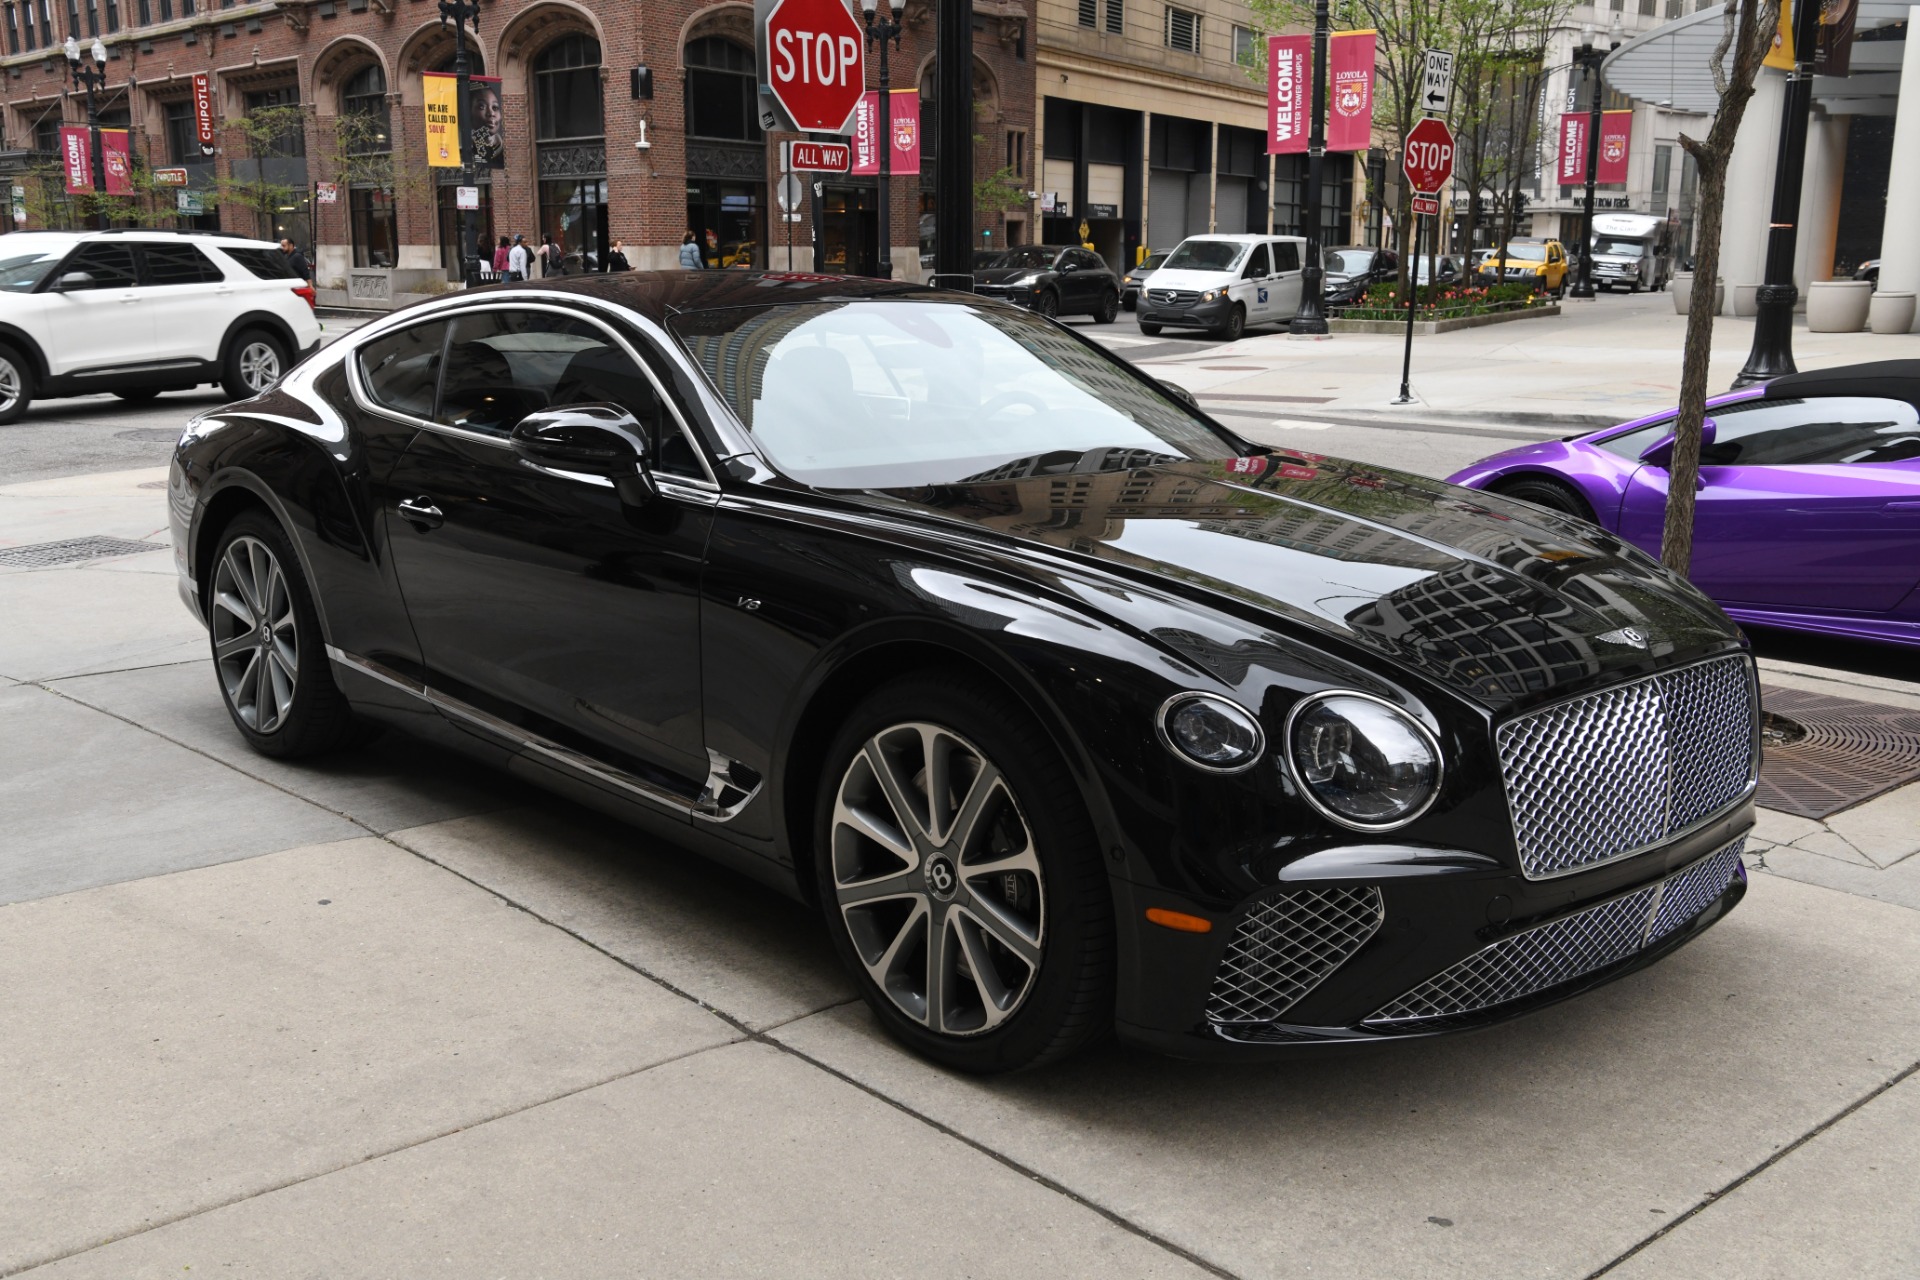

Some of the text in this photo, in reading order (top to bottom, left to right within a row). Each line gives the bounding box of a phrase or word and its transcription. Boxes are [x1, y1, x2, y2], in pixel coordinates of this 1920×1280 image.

[775, 28, 858, 87] STOP
[1295, 53, 1303, 84] CAMPUS
[1429, 55, 1449, 72] ONE
[1336, 70, 1368, 80] LOYOLA
[1427, 72, 1448, 88] WAY
[1276, 48, 1293, 142] WELCOME
[1567, 88, 1576, 114] NOR
[197, 78, 211, 140] CHIPOTLE
[428, 104, 448, 113] WE ARE
[428, 114, 456, 124] CALLED TO
[428, 125, 446, 134] SOLVE
[857, 100, 869, 168] WELCOME
[1294, 112, 1302, 136] WATER
[66, 134, 83, 187] WELCOME
[797, 147, 844, 167] ALL WAY
[1407, 140, 1451, 171] STOP
[1564, 120, 1577, 177] WELCOME
[1414, 201, 1437, 212] ALL WAY
